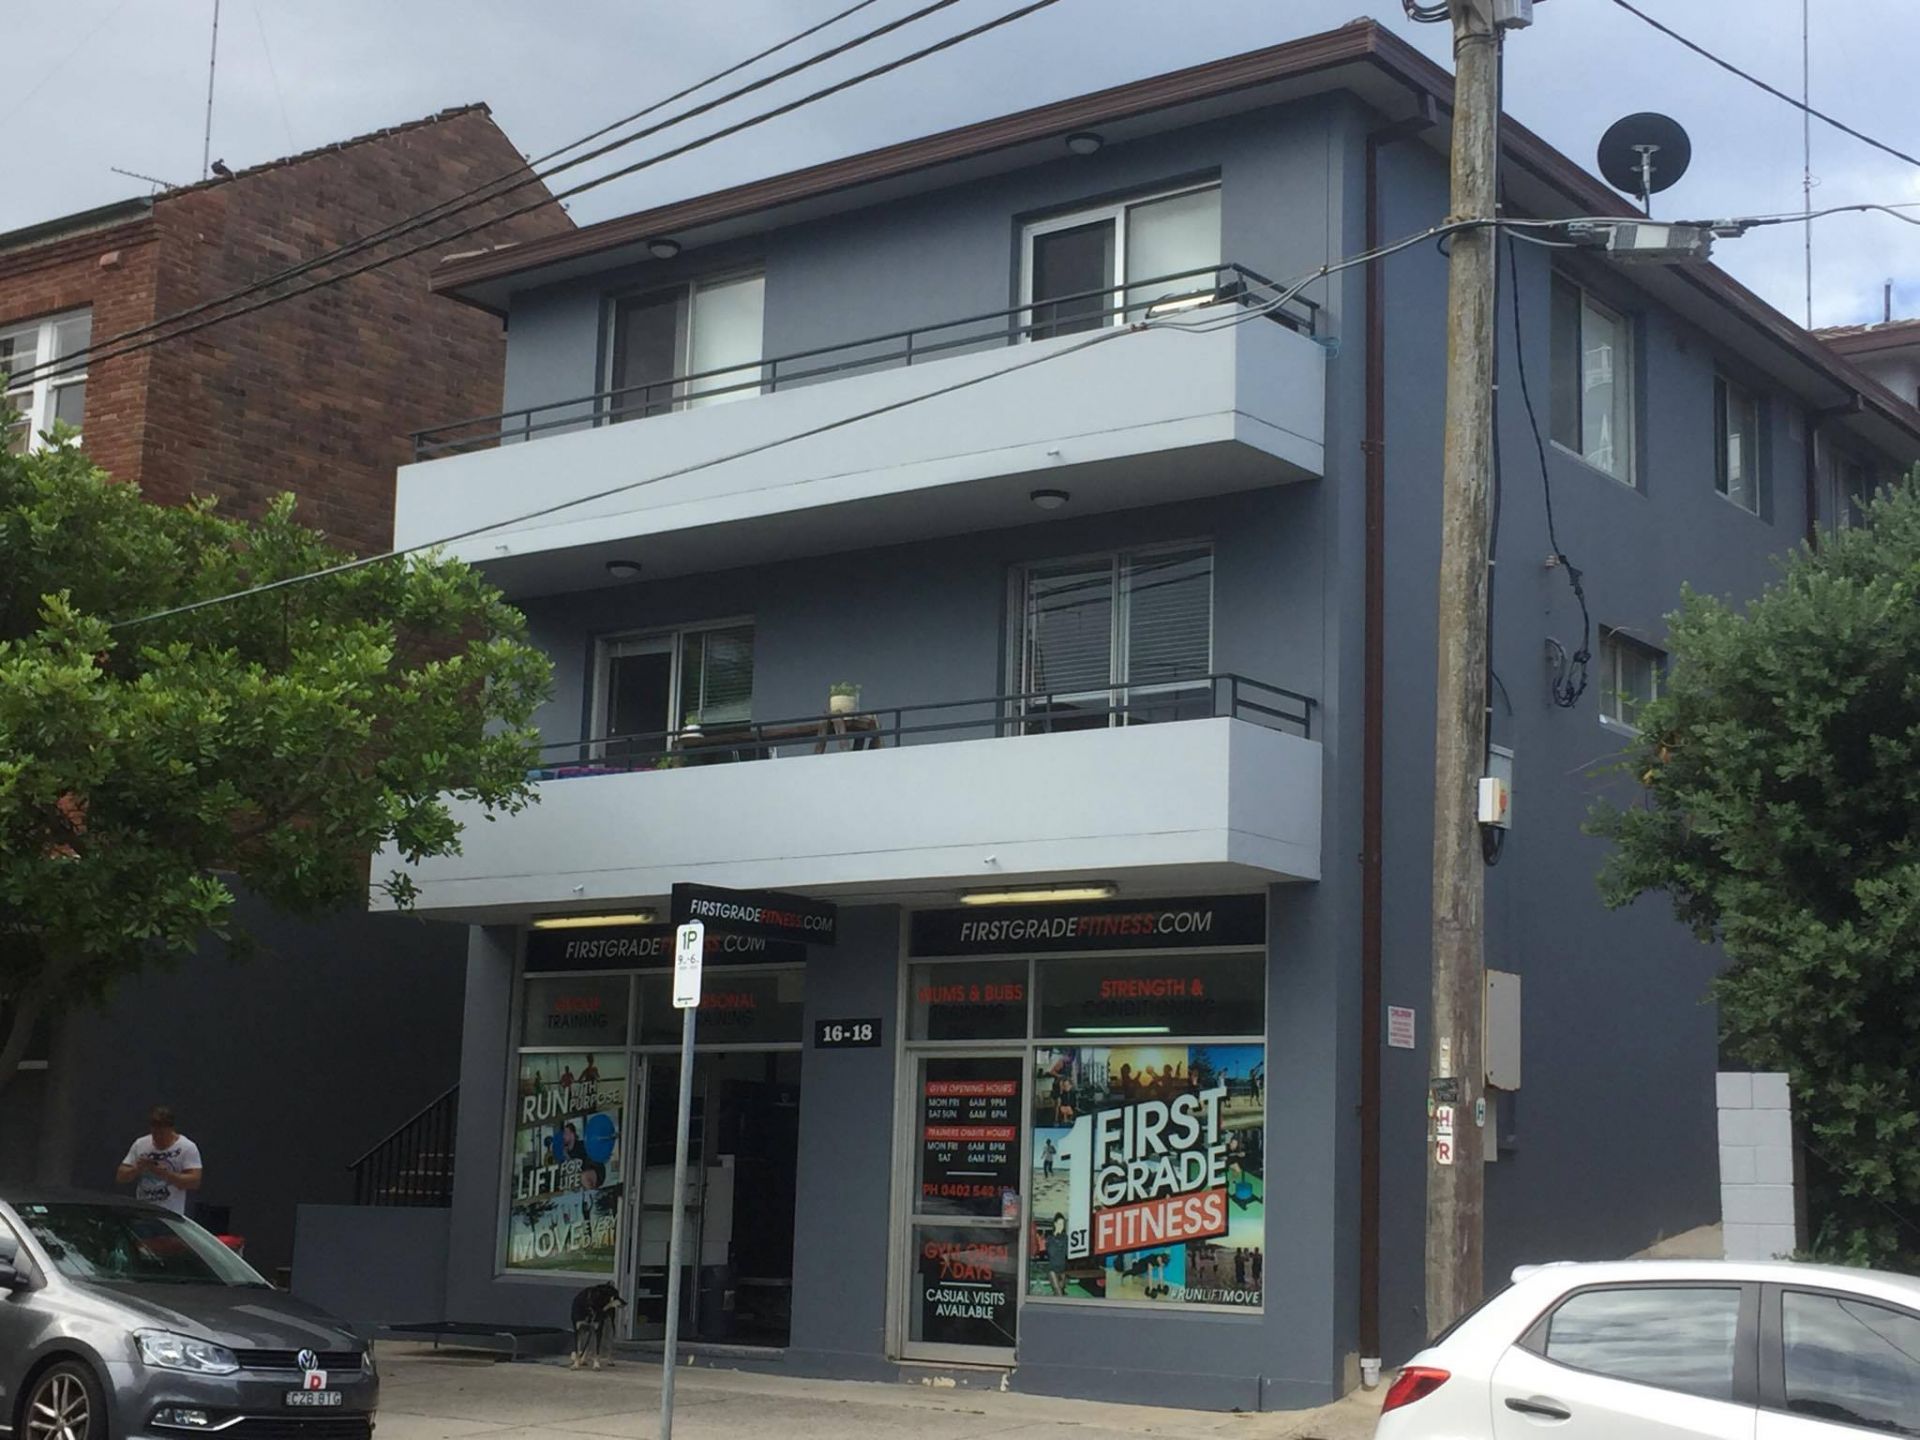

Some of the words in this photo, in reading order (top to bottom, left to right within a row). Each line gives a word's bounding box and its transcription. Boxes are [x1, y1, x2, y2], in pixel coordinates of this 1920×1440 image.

[690, 899, 833, 932] FIRSTGRADEFITNESS.COM
[961, 911, 1213, 942] FIRSTGRADEFITNESS.COM
[682, 930, 698, 950] 1P
[1100, 977, 1185, 998] STRENGTH
[822, 1023, 873, 1042] 16-18
[522, 1085, 571, 1124] RUN
[928, 1098, 948, 1107] MON
[928, 1109, 941, 1118] SAT
[942, 1109, 958, 1118] SUN
[1097, 1087, 1227, 1164] FIRST
[938, 1153, 952, 1162] SAT
[518, 1163, 560, 1200] LIFT
[560, 1158, 584, 1175] FOR
[559, 1173, 583, 1190] LIFE
[1099, 1145, 1227, 1207] GRADE
[1098, 1193, 1223, 1250] FITNESS
[513, 1221, 582, 1263] MOVE
[1070, 1229, 1088, 1248] ST
[953, 1263, 993, 1281] DAYS
[926, 1289, 970, 1303] CASUAL
[972, 1291, 1006, 1306] VISITS
[936, 1304, 994, 1319] AVAILABLE
